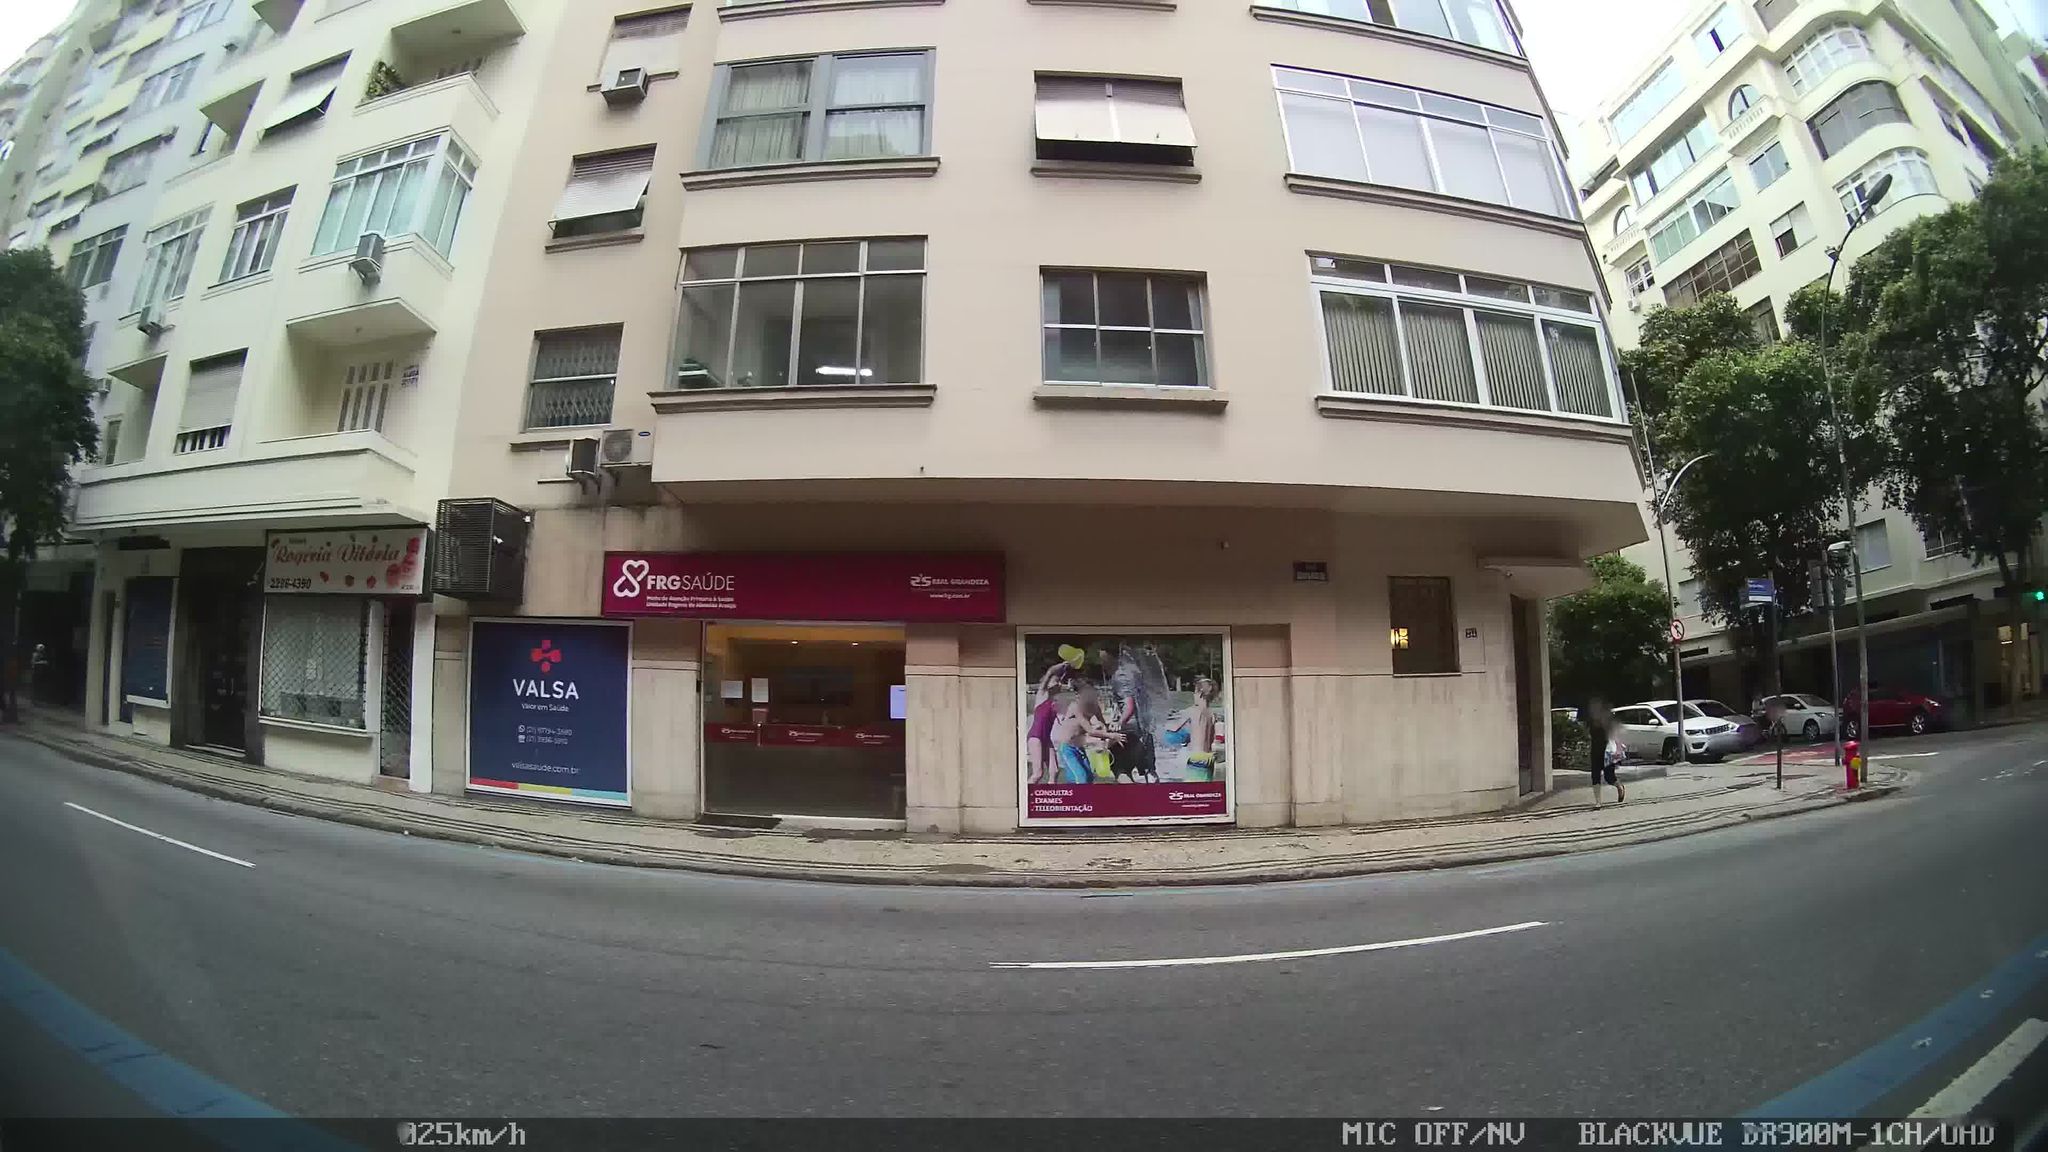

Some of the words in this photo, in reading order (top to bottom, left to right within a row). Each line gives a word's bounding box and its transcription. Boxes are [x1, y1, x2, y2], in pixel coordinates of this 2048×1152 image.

[646, 572, 735, 590] FRGSAÚDE
[513, 678, 580, 700] VALSA
[521, 702, 537, 711] Valor
[537, 703, 549, 712] em
[1034, 804, 1093, 813] TELEORIENTAÇÃO
